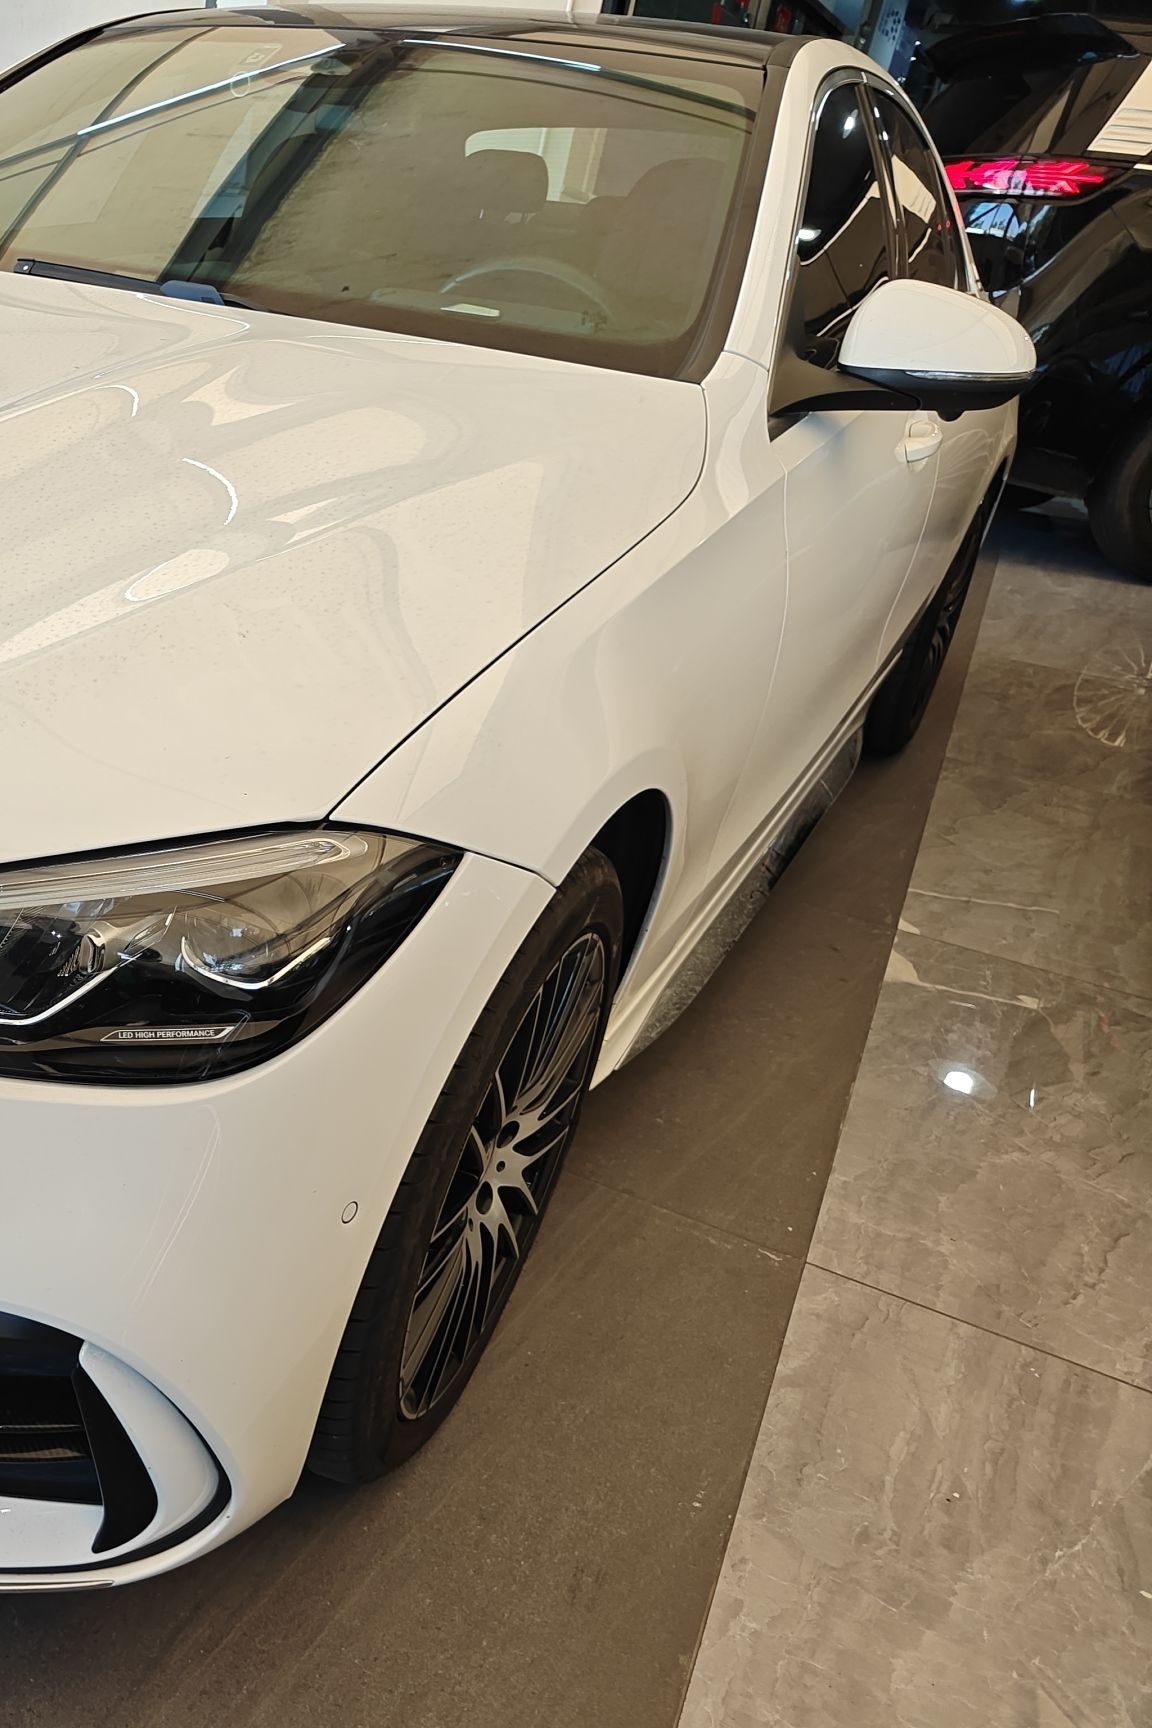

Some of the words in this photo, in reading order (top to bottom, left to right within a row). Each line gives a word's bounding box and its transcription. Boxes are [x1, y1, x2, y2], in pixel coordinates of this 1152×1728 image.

[118, 1031, 134, 1039] LED
[135, 1030, 154, 1039] HIGH
[156, 1029, 216, 1039] PERFORMANCE
